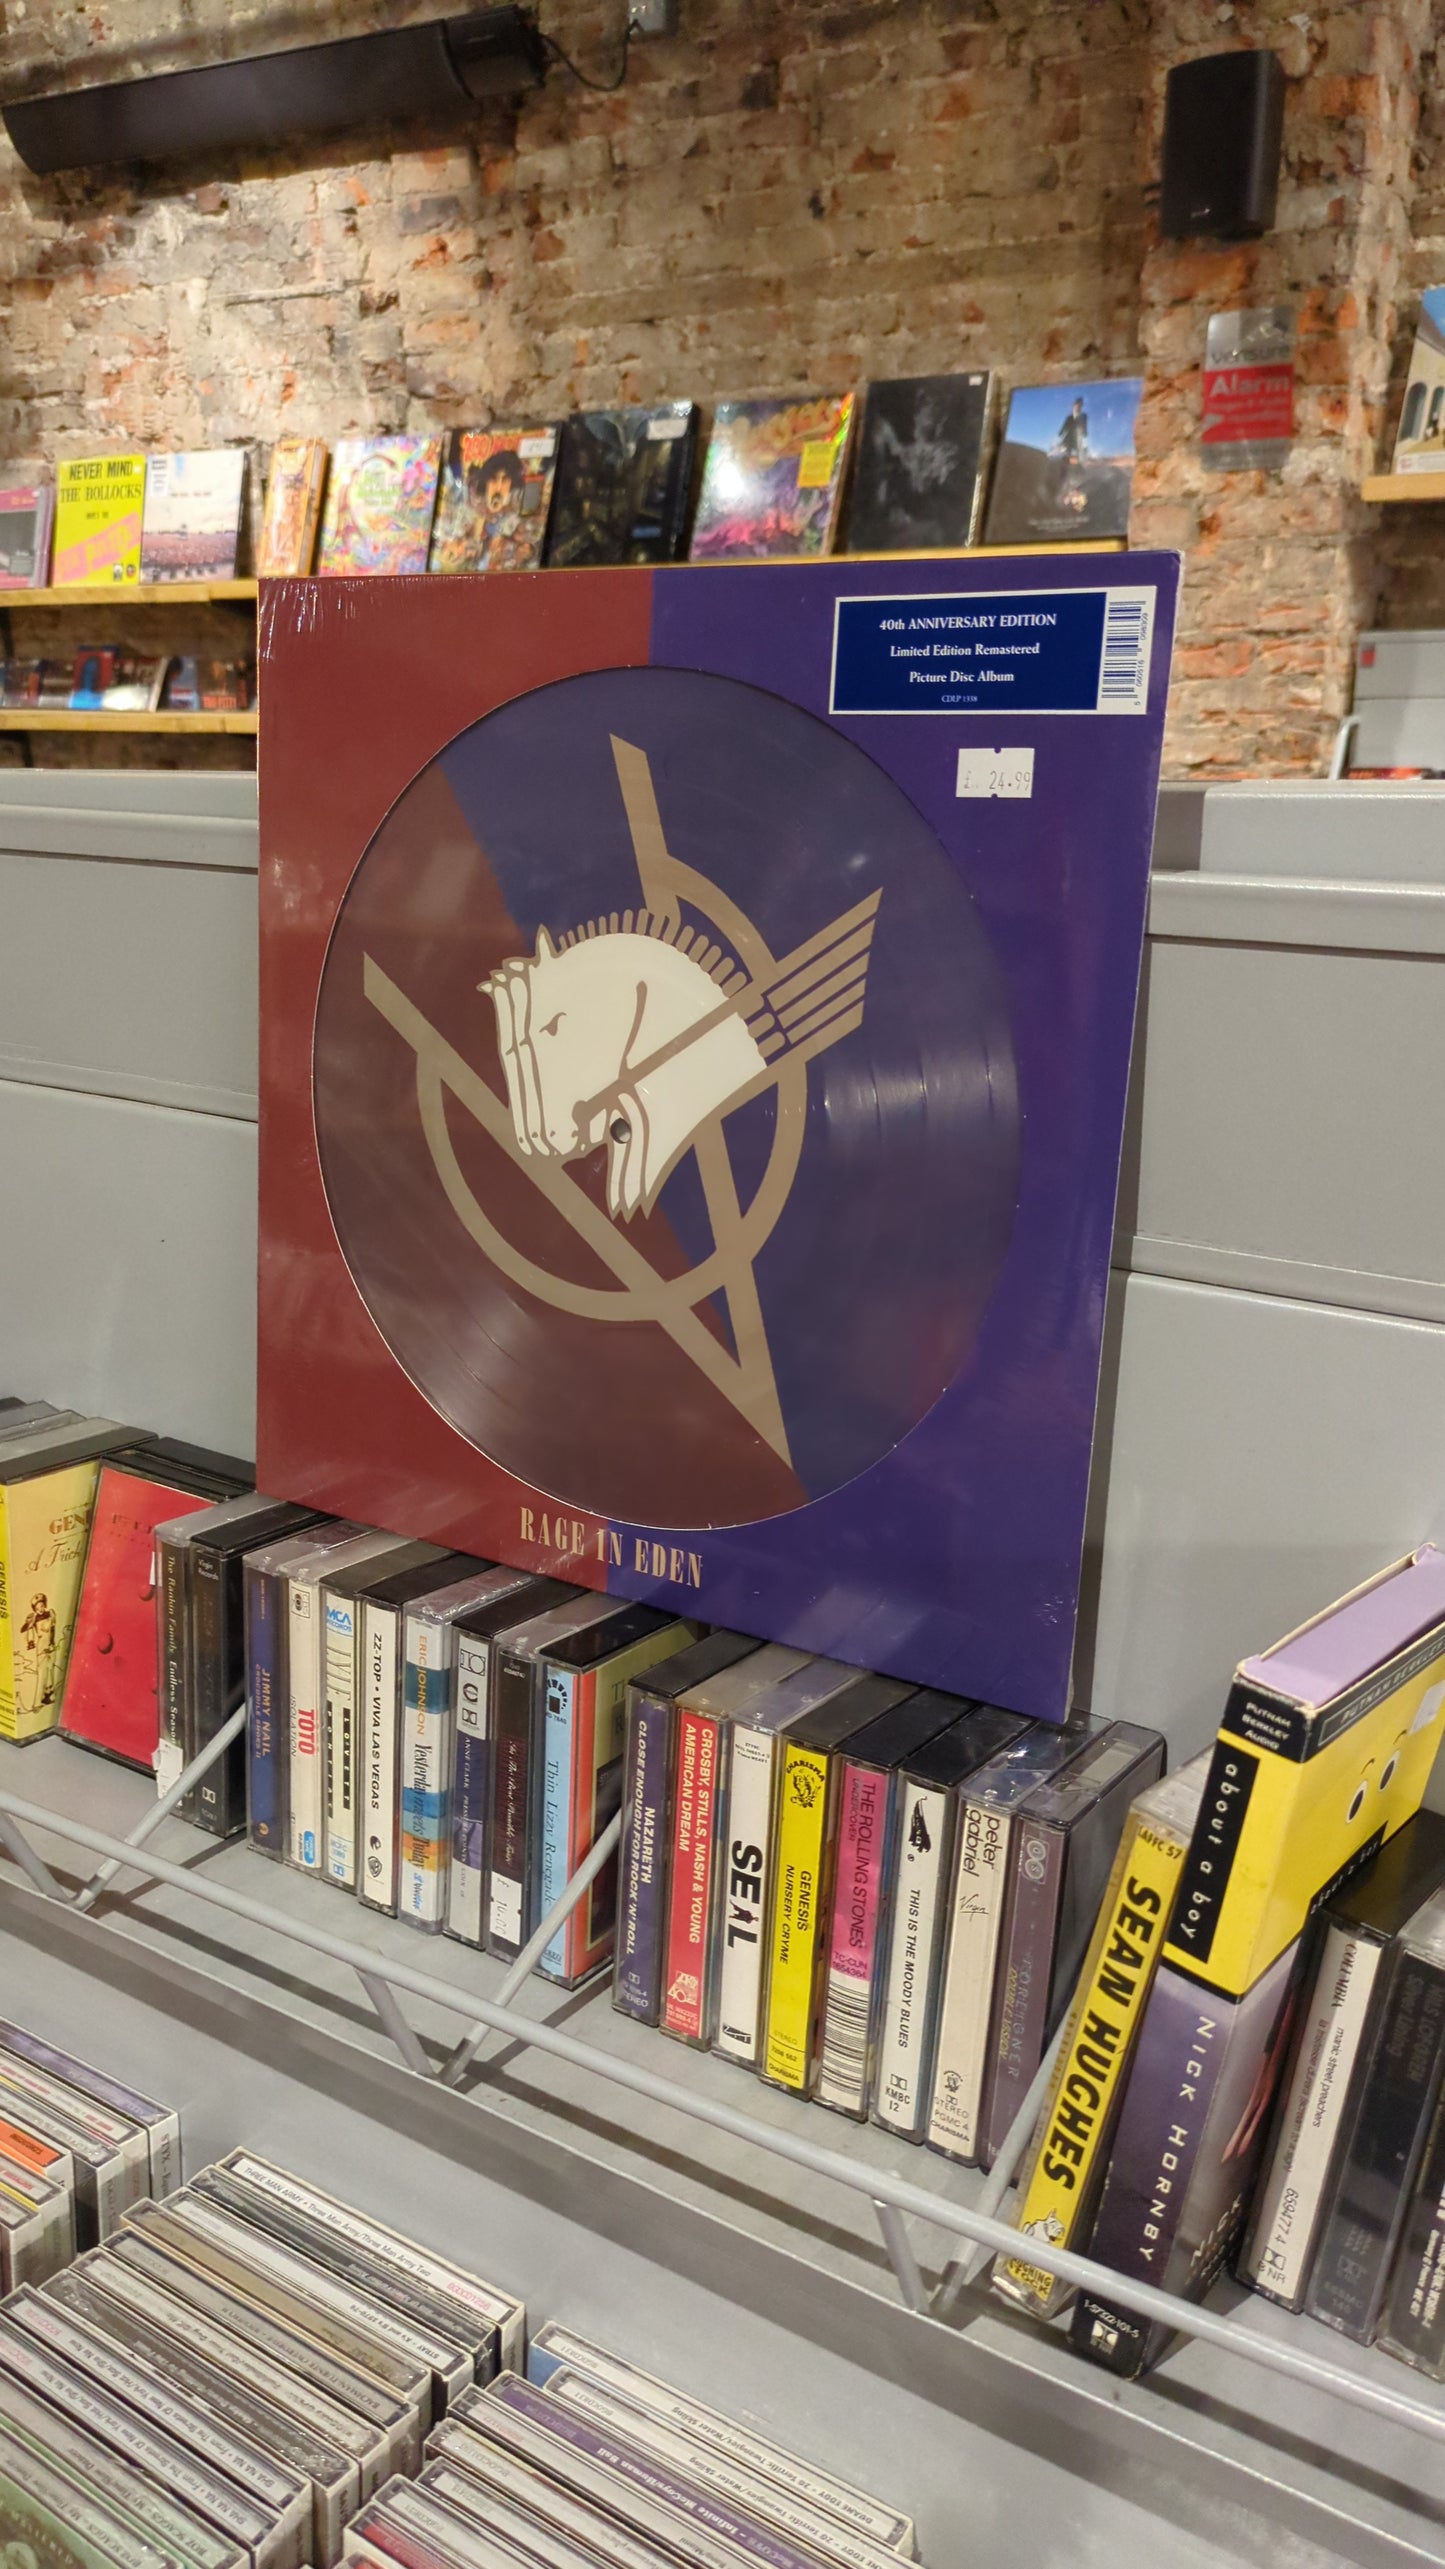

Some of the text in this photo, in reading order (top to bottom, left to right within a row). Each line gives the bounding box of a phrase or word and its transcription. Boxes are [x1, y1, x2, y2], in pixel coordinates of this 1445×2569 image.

[1209, 374, 1290, 397] Alarm
[69, 462, 102, 480] NEVER
[107, 460, 134, 478] MIND
[61, 484, 142, 503] THE BOLLOCKS
[880, 613, 1057, 631] 40th ANNIVERSARY EDITION
[890, 642, 1040, 657] Limited Edition Remastered
[909, 670, 1014, 683] Picture Disc Album
[989, 770, 1031, 791] 24.99
[519, 1506, 703, 1589] RAGE IN EDEN
[168, 1556, 179, 1702] The Rankin Family Endless
[326, 1605, 352, 1625] MCA
[416, 1635, 428, 1735] ERIC JOHNSON
[262, 1668, 271, 1757] JIMMY NAIL
[289, 1695, 297, 1757] ISOLATION
[371, 1633, 382, 1810] ZZ-TOP VIVA LAS VEGAS
[1245, 1702, 1292, 1727] PUTNAM
[298, 1709, 316, 1756] TOTO
[1241, 1714, 1290, 1742] BERKLEY
[1244, 1729, 1280, 1751] AUDIO
[463, 1737, 471, 1761] ANNE
[636, 1720, 647, 1768] CLOSE
[463, 1763, 471, 1788] CLARK
[785, 1759, 826, 1782] CHARISMA
[545, 1761, 559, 1838] Thin Lizzy
[633, 1769, 645, 1831] ENOUGH
[679, 1723, 697, 1851] AMERICAN DREAM
[631, 1831, 641, 1858] FOR
[640, 1806, 656, 1884] NAZARETH
[689, 1728, 713, 1944] CROSBY, STILLS, NASH & YOUNG
[963, 1807, 985, 1877] gabriel
[982, 1814, 1003, 1870] peter
[1180, 1763, 1241, 1939] about a boy
[849, 1783, 876, 1949] THE ROLLING STONES
[629, 1859, 640, 1903] ROCK
[779, 1864, 796, 1965] NURSERY CRYME
[797, 1870, 812, 1931] GENESIS
[960, 1893, 989, 1922] Virgin
[626, 1922, 636, 1955] ROLL
[1096, 1876, 1161, 2008] SEAN
[898, 1888, 920, 2048] THIS IS THE MOODY BLUES
[1331, 1943, 1358, 2009] COLUMBIA
[1007, 1956, 1033, 2078] FOREIGNER
[768, 2062, 800, 2082] CHARISMA
[1312, 2026, 1345, 2128] manic street preachers
[884, 2086, 911, 2105] KMBC
[889, 2099, 900, 2113] 12
[934, 2096, 970, 2119] STEREO
[1043, 2010, 1122, 2190] HUGHES
[930, 2119, 970, 2142] CHARISMA
[1138, 2016, 1217, 2262] NICK HORNBY
[243, 2165, 267, 2184] THREE
[264, 2177, 281, 2192] MAN
[279, 2185, 302, 2203] ARMY
[307, 2202, 327, 2218] Three
[325, 2212, 343, 2227] Man
[379, 2243, 397, 2258] Man
[395, 2252, 416, 2270] Army
[1267, 2268, 1287, 2284] NR
[416, 2342, 440, 2361] STRAY
[148, 2395, 165, 2409] New
[170, 2411, 197, 2433] Streets
[194, 2428, 210, 2442] The
[208, 2438, 229, 2455] From
[232, 2454, 246, 2467] NA
[243, 2462, 258, 2476] NA
[256, 2472, 275, 2488] SHA
[596, 2445, 739, 2535] Infinite McCoys/Human Ball
[817, 2487, 842, 2507] EDDY
[841, 2501, 873, 2525] DUANE
